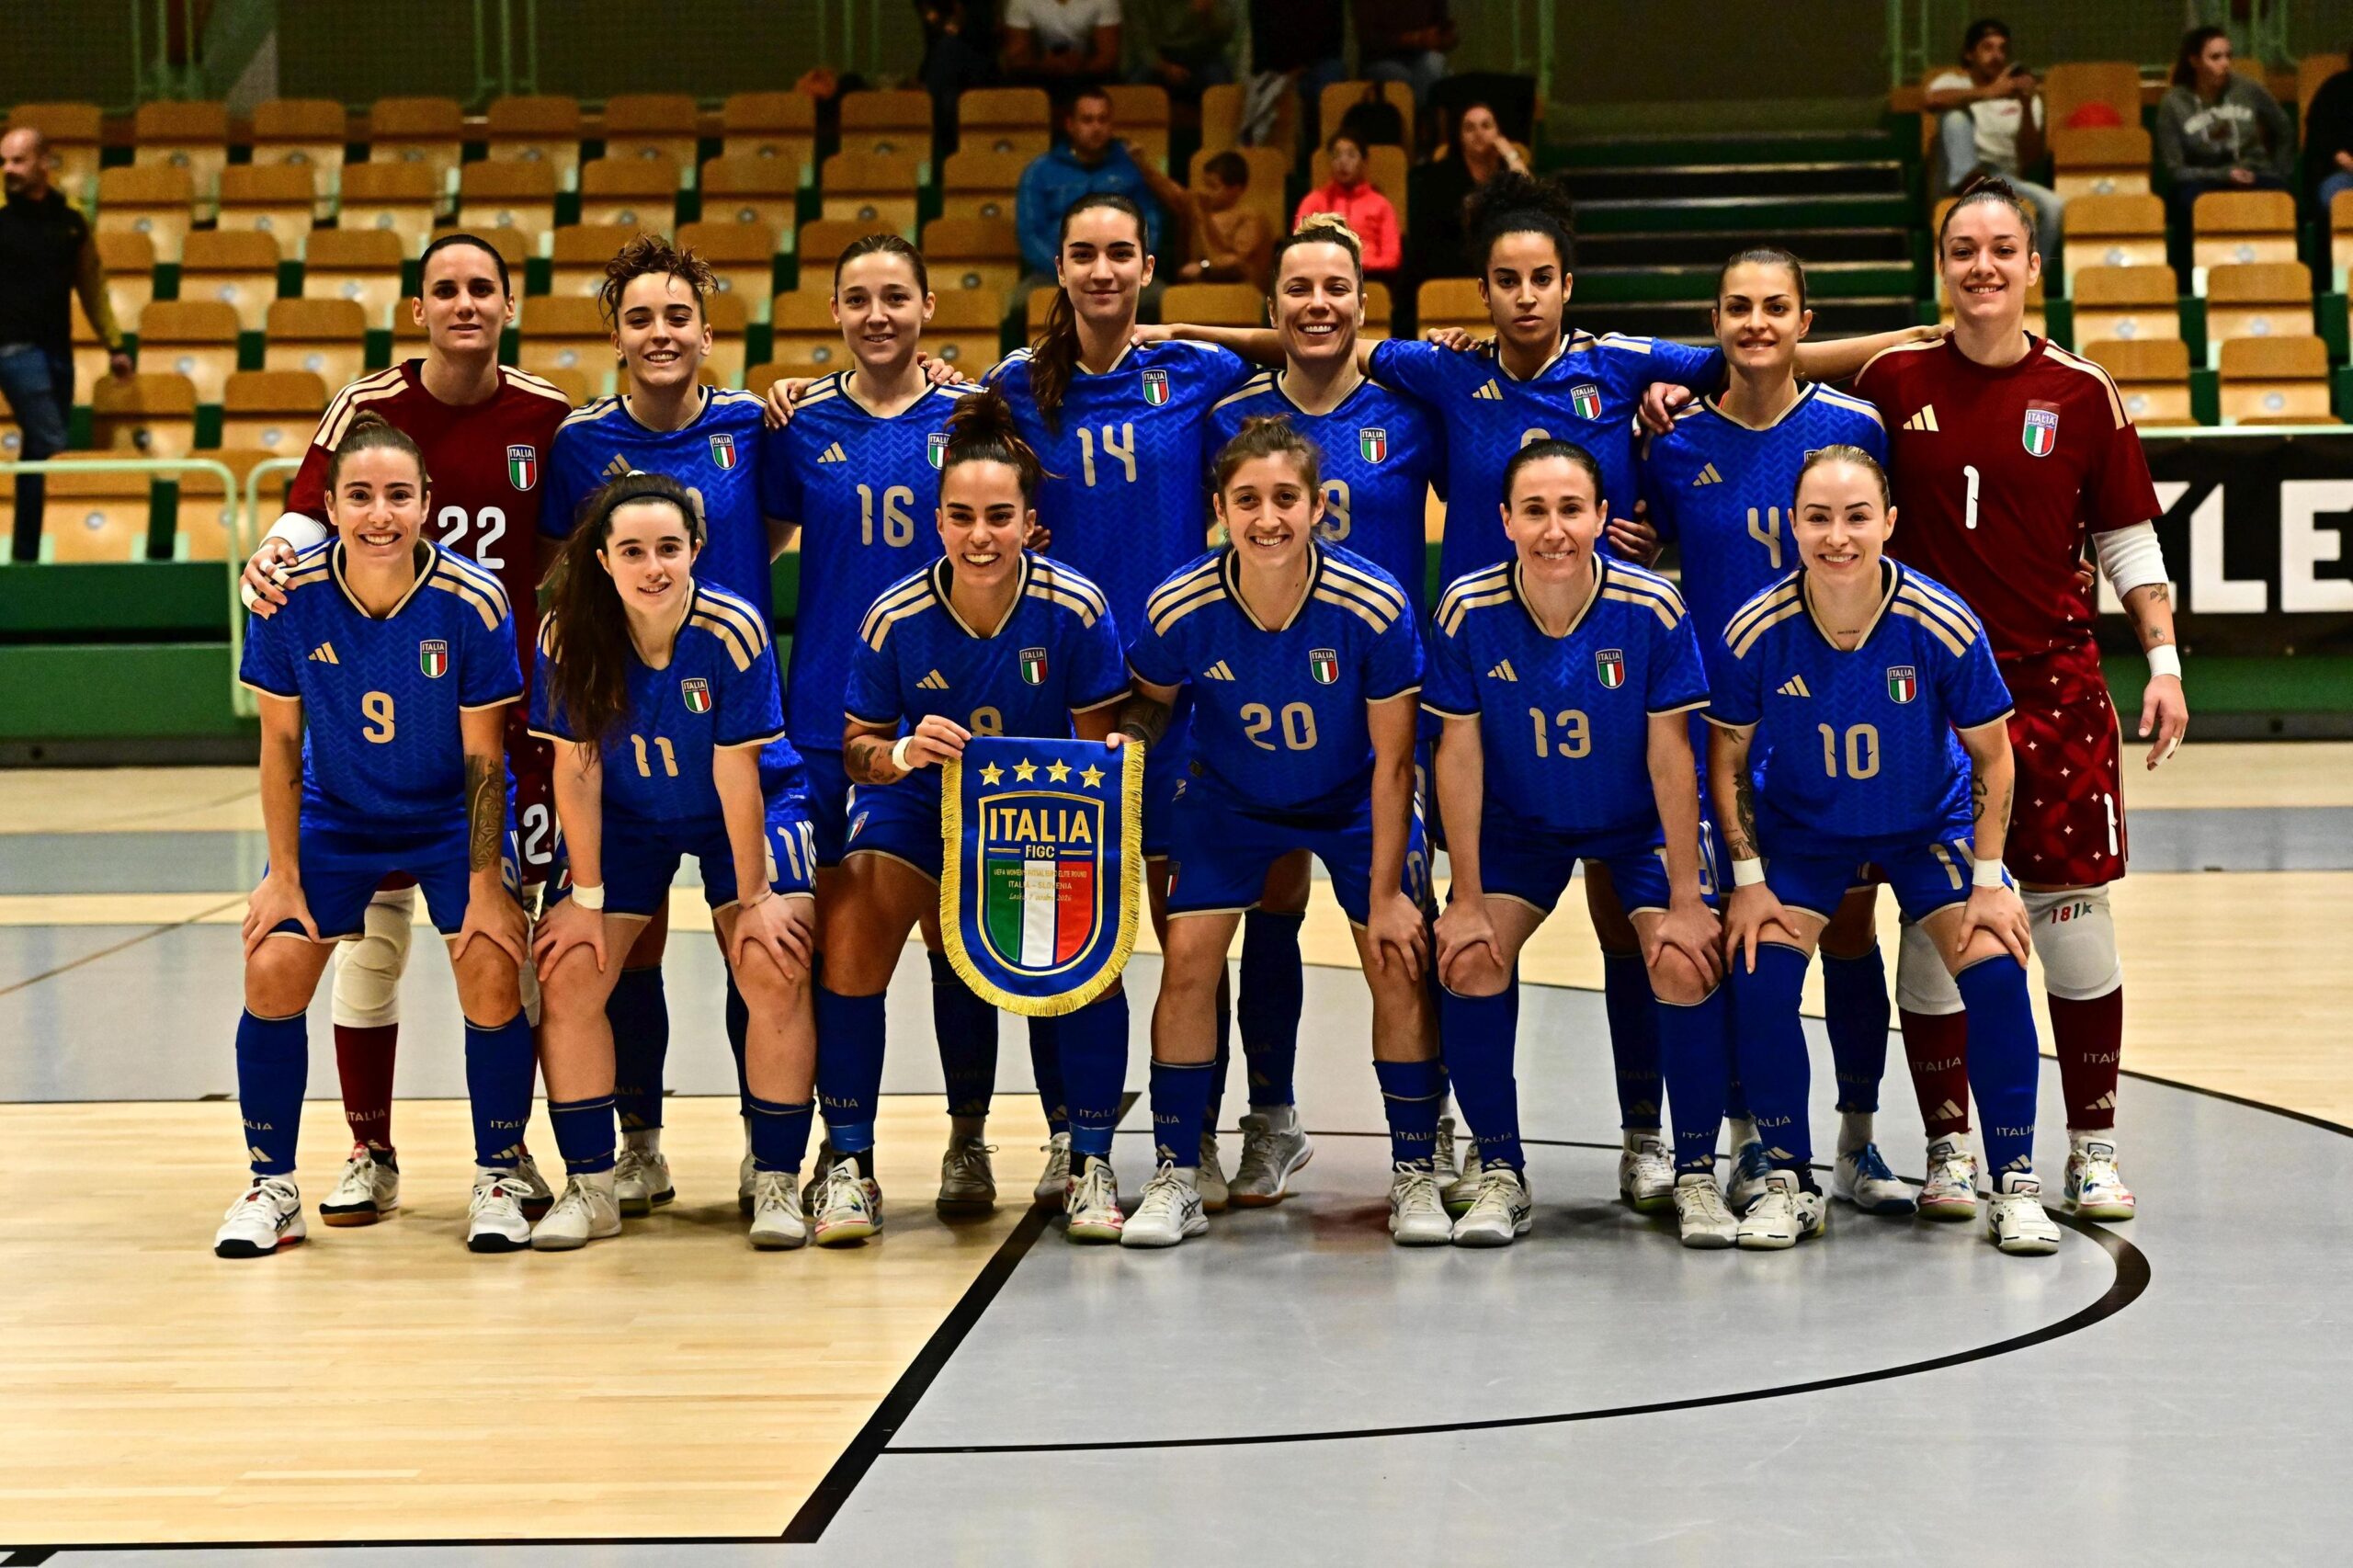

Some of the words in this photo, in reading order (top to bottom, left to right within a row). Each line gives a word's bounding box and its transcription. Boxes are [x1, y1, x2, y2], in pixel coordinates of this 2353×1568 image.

[1573, 387, 1596, 396] ITALIA
[2028, 413, 2054, 426] ITALIA
[509, 449, 533, 458] ITALIA
[1076, 422, 1137, 487] 14
[857, 483, 915, 548] 16
[1963, 465, 1980, 529] 1
[438, 506, 506, 570] 22
[1747, 506, 1781, 569] 4
[1598, 653, 1620, 661] ITALIA
[1890, 669, 1913, 677] ITALIA
[684, 681, 705, 689] ITALIA
[361, 691, 395, 744] 9
[1240, 701, 1318, 751] 20
[1529, 707, 1591, 758] 13
[631, 733, 678, 777] 11
[1817, 722, 1880, 779] 10
[989, 808, 1092, 843] ITALIA
[2104, 792, 2119, 856] 1
[1025, 845, 1055, 858] FIGC
[1912, 1056, 1961, 1074] ITALIA
